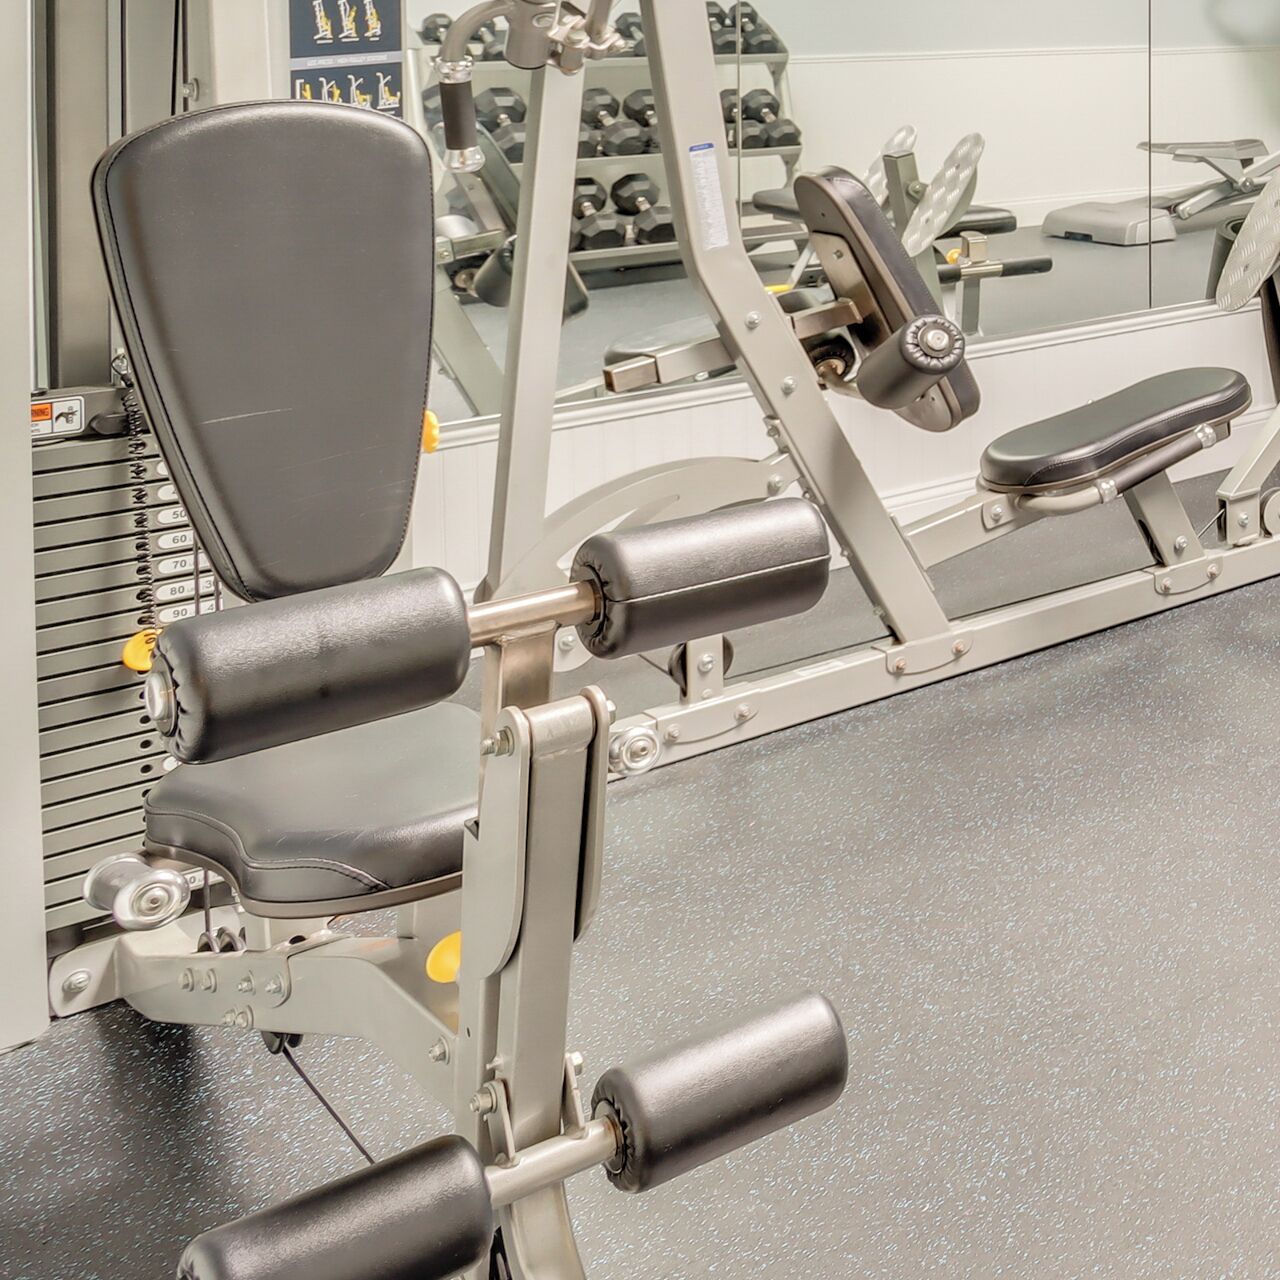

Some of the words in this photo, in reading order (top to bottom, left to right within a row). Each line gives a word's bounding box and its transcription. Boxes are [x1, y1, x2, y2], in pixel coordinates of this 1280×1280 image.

[172, 506, 187, 519] 50
[172, 534, 187, 544] 60
[172, 560, 187, 569] 70
[170, 586, 185, 595] 80
[172, 609, 187, 619] 90
